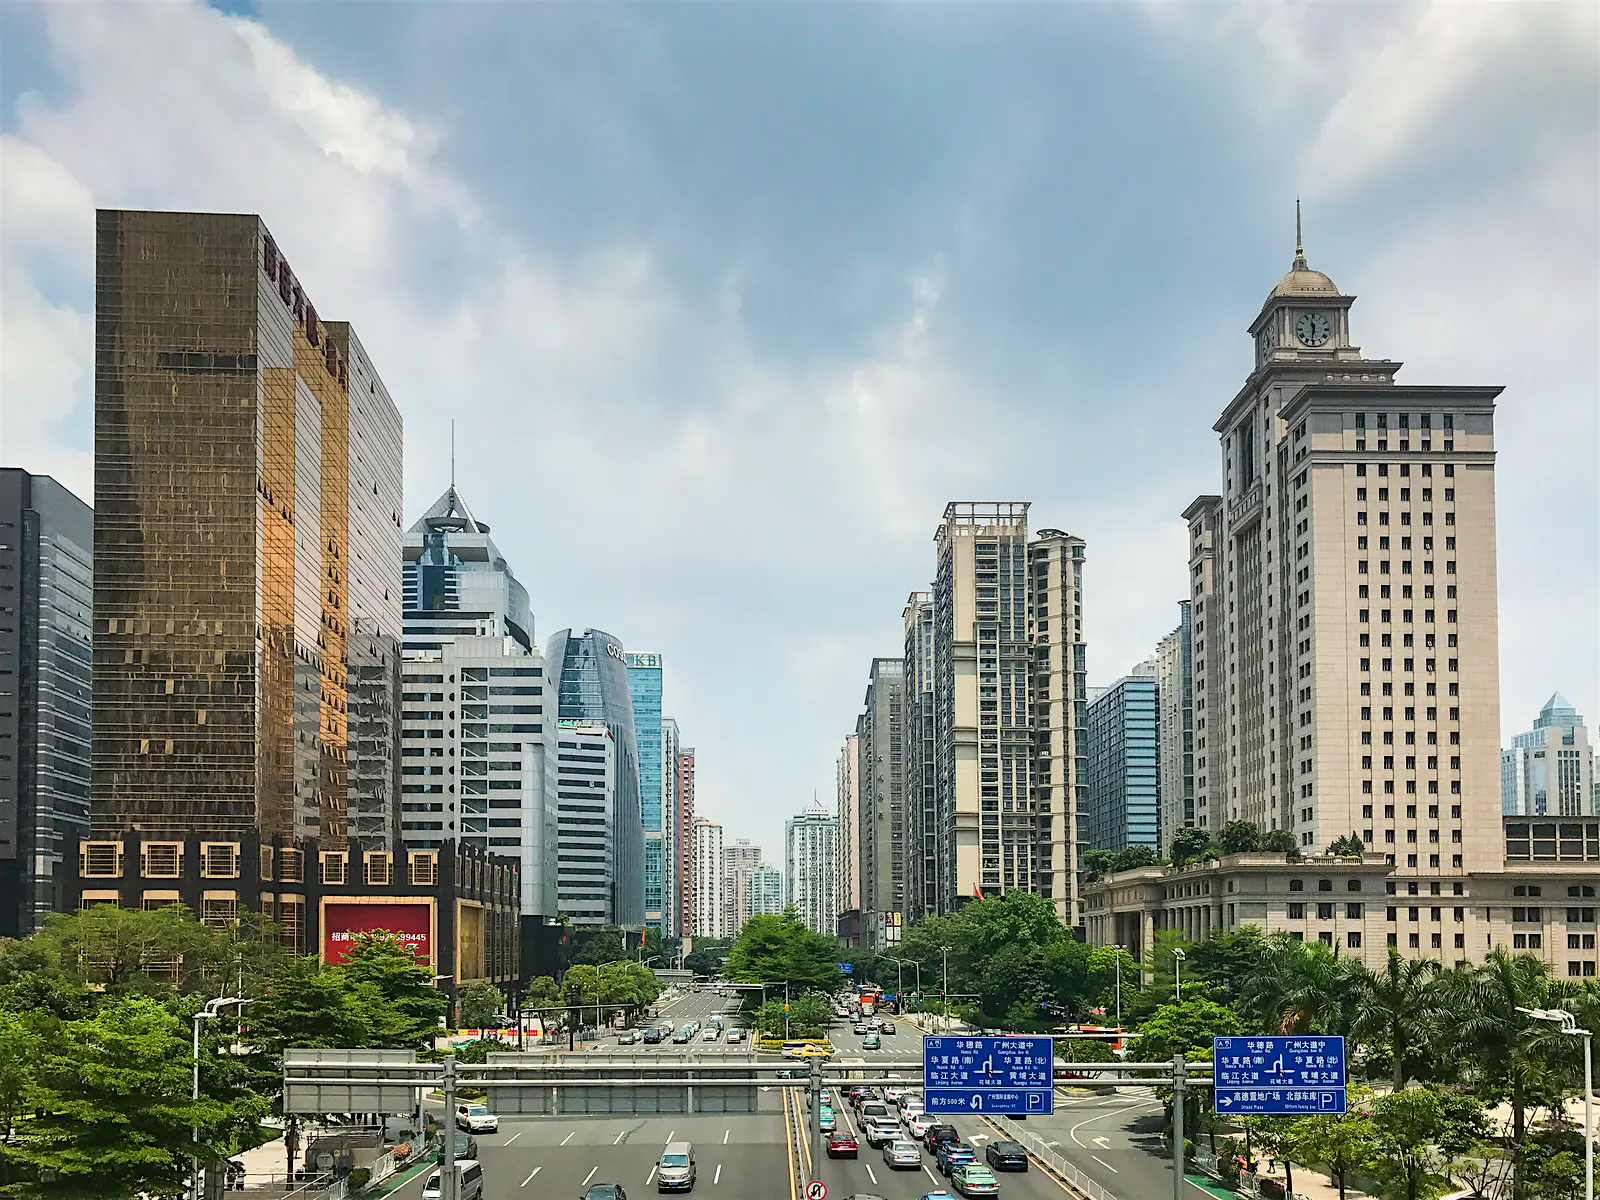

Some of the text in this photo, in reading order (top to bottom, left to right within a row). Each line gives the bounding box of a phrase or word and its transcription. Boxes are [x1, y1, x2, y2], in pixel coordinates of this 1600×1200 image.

[635, 654, 656, 666] KB
[956, 1040, 983, 1049] 华穗路
[993, 1041, 1034, 1050] 广州大道中
[1246, 1041, 1274, 1049] 华穗路
[1285, 1040, 1326, 1049] 广州大道中
[930, 1071, 968, 1080] 临江大道
[1009, 1071, 1046, 1080] 黄埔大道
[1221, 1072, 1259, 1080] 临江大道
[1300, 1071, 1339, 1079] 黄埔大道
[1234, 1092, 1280, 1101] 高德置地广场
[1286, 1092, 1317, 1101] 北部车库
[1321, 1094, 1332, 1108] P
[931, 1097, 966, 1106] 前方500米
[1029, 1094, 1040, 1109] P
